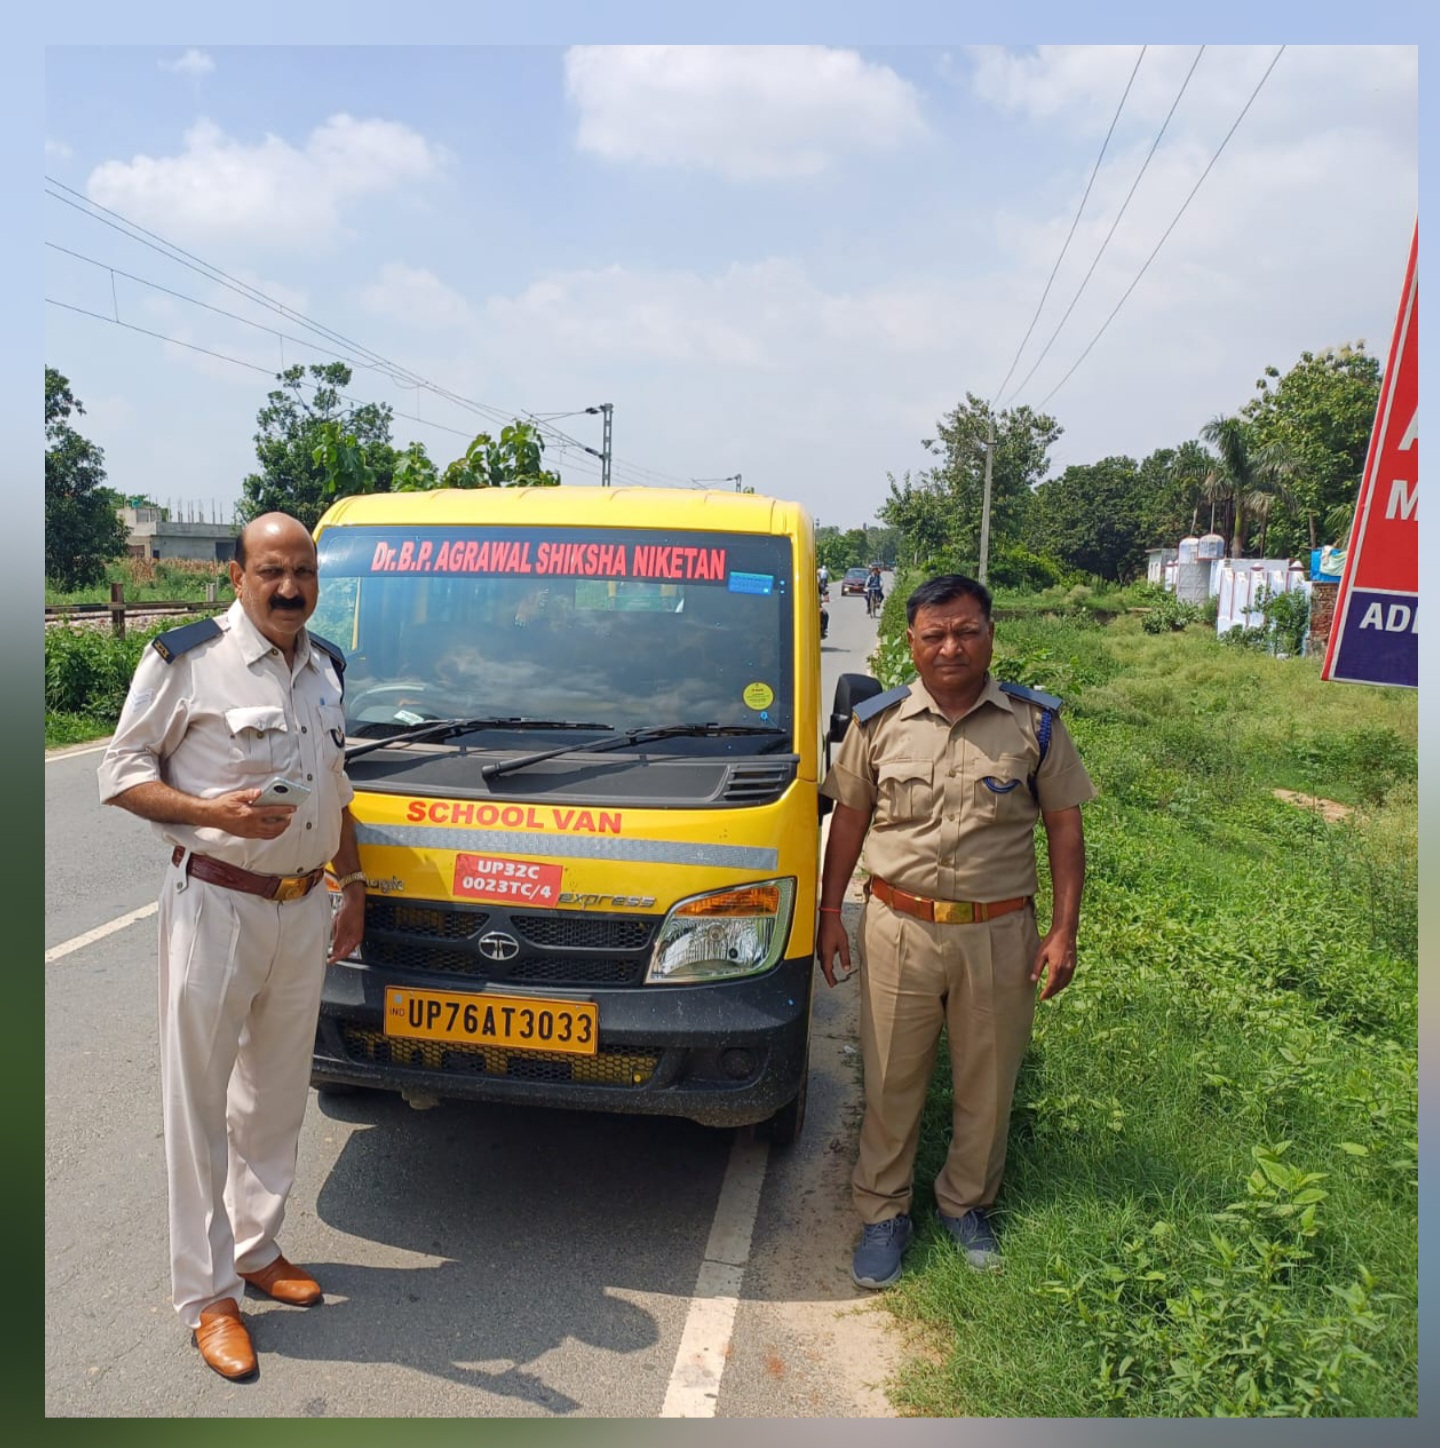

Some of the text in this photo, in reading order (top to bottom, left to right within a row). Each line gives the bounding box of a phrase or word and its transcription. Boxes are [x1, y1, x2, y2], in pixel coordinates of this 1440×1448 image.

[434, 540, 531, 575] AGRAWAL
[535, 542, 627, 578] SHIKSHA
[632, 545, 726, 581] NIKETAN
[1359, 602, 1418, 634] AD
[406, 800, 622, 835] SCHOOL VAN
[477, 859, 540, 880] UP32C
[462, 876, 552, 900] 0023TC/4
[558, 893, 657, 910] express
[408, 998, 592, 1044] UP76AT3033
